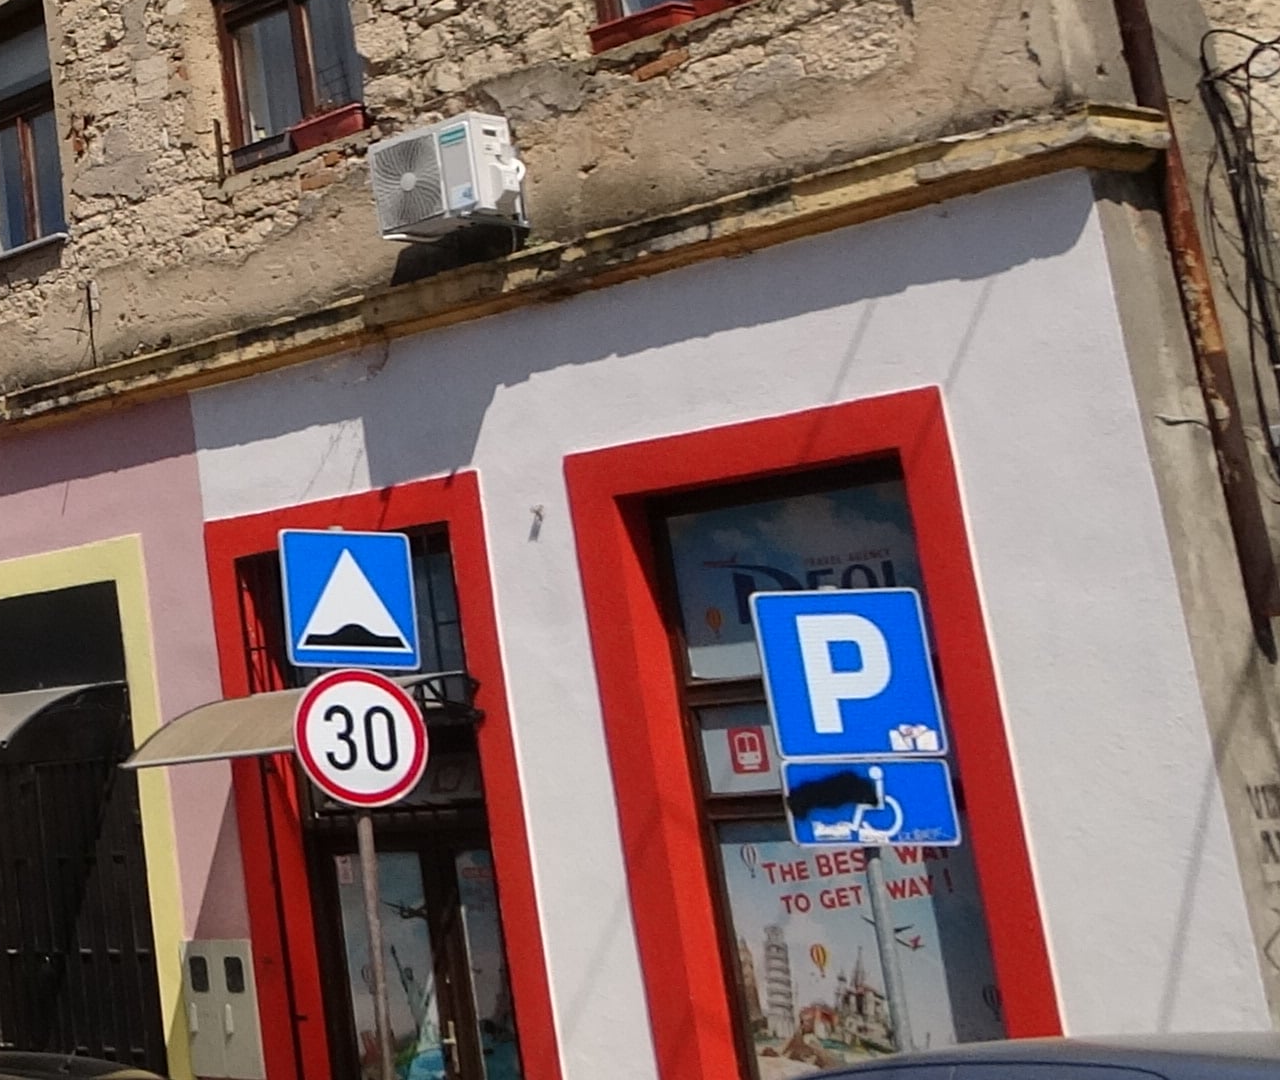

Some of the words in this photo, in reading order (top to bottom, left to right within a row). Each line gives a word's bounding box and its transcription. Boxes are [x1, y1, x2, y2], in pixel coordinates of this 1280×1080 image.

[795, 613, 891, 734] P
[323, 704, 399, 772] 30
[762, 861, 809, 884] THE
[815, 849, 869, 877] BES
[780, 893, 811, 914] TO
[820, 886, 862, 909] GET
